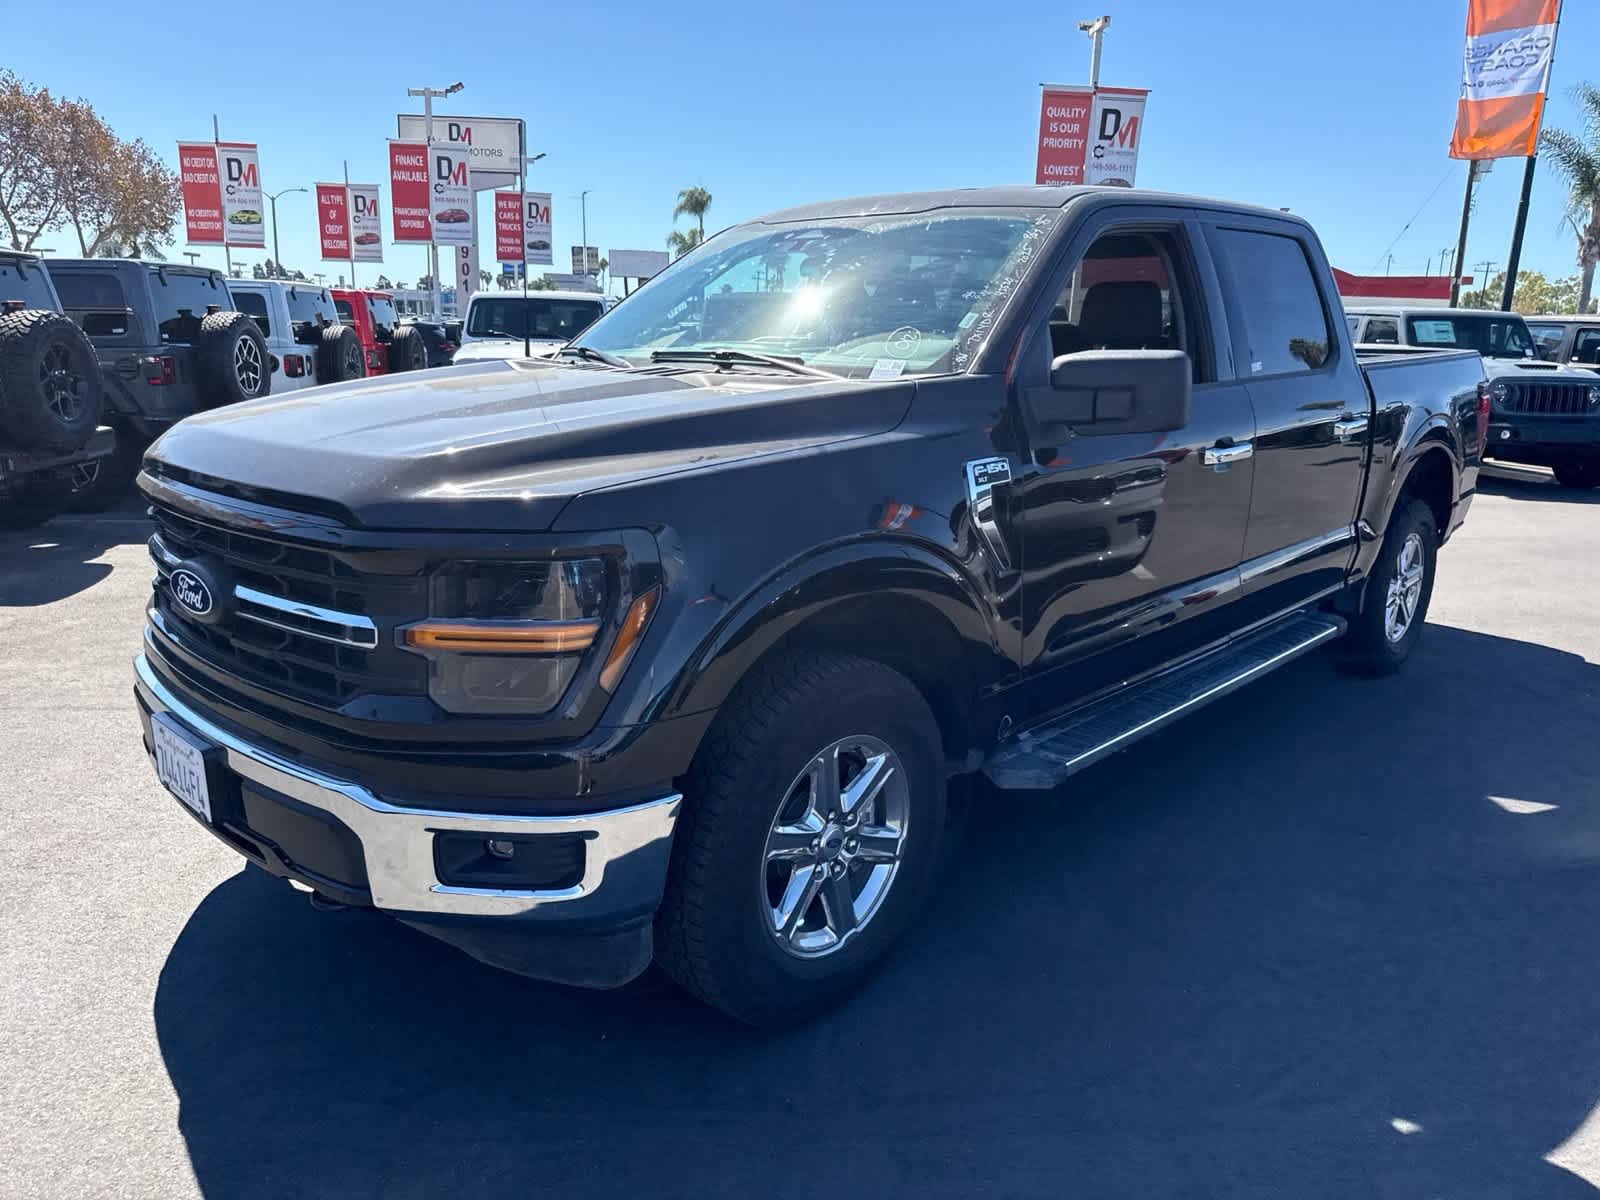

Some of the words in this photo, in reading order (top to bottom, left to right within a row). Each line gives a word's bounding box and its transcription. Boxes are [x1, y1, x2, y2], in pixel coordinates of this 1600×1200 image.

[1046, 106, 1087, 118] QUALITY
[1049, 122, 1058, 132] IS
[1059, 123, 1080, 133] OUR
[1043, 137, 1085, 149] PRIORITY
[395, 154, 424, 167] FINANCE
[1043, 164, 1080, 176] LOWEST
[392, 170, 428, 183] AVAILABLE
[497, 200, 507, 209] WE
[328, 209, 337, 220] OF
[498, 211, 514, 220] CARS
[325, 224, 343, 235] CREDIT
[498, 223, 521, 232] TRUCKS
[177, 573, 204, 610] Ford
